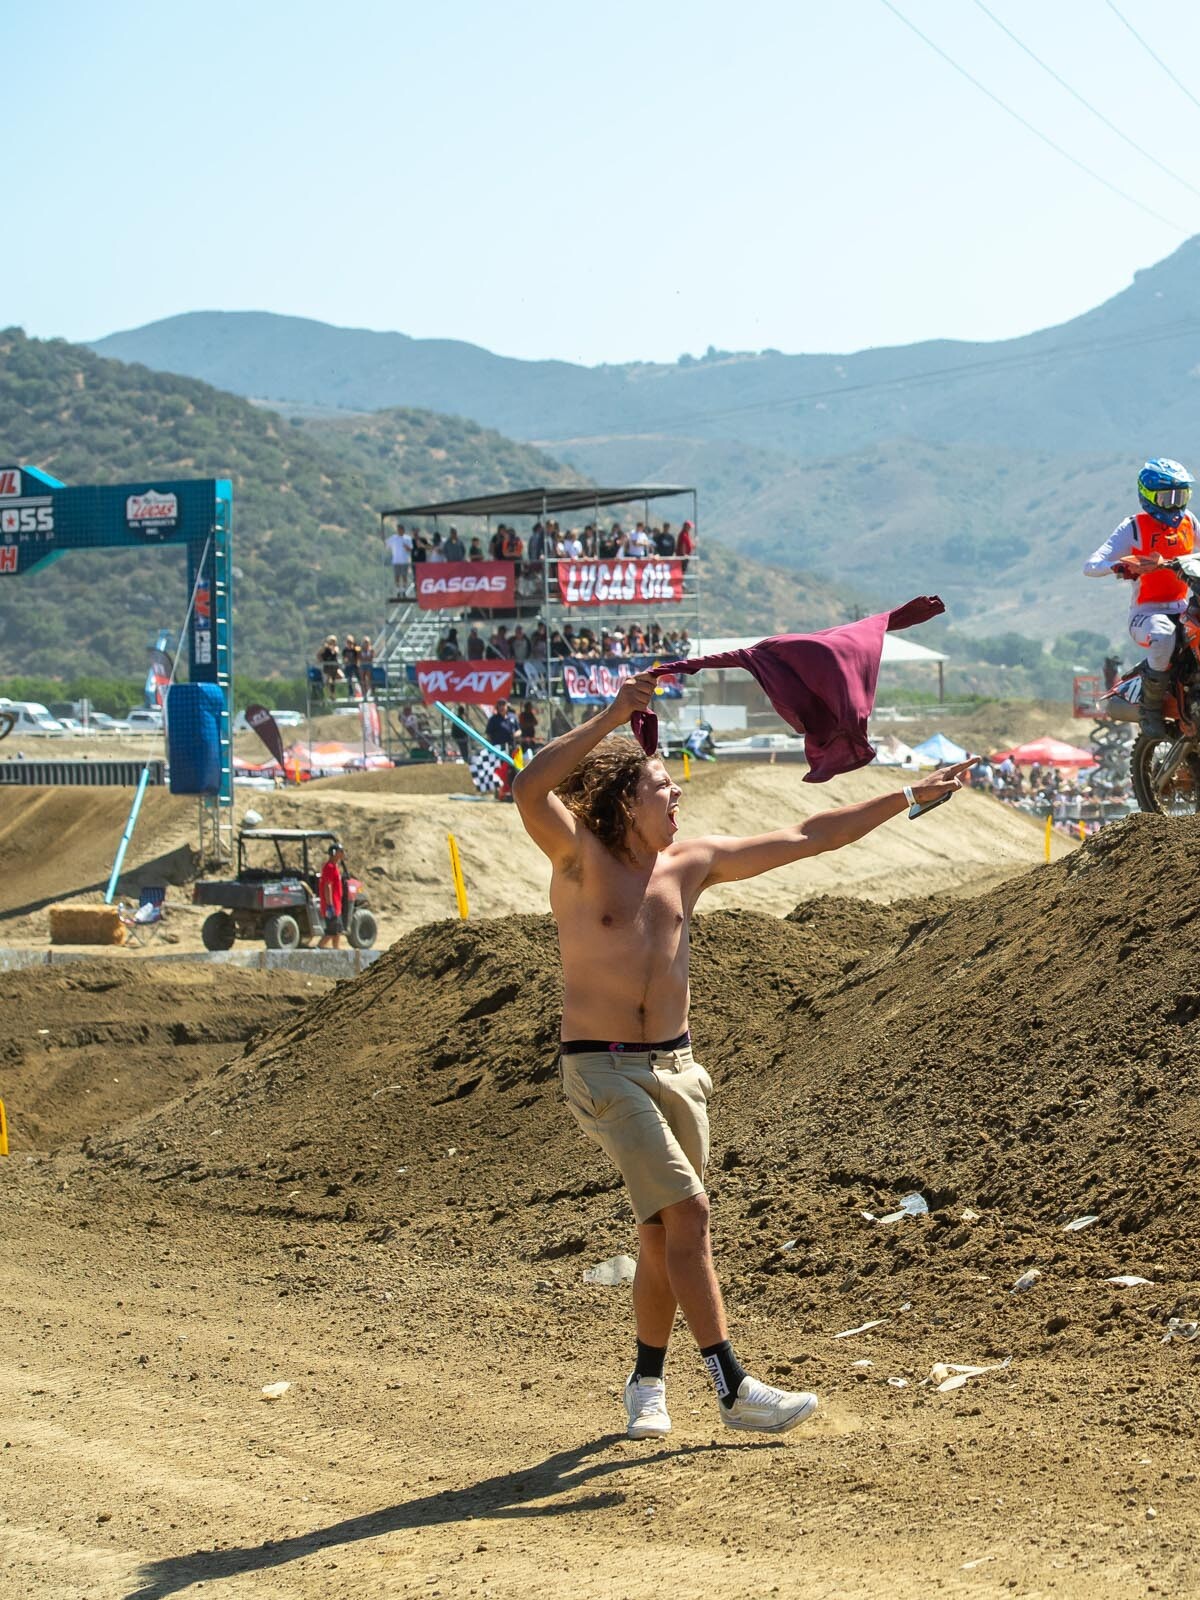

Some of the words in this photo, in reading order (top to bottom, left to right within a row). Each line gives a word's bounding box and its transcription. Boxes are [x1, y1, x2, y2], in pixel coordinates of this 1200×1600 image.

[0, 506, 54, 533] OSS
[420, 576, 506, 594] GASGAS
[566, 564, 638, 602] LUCAS
[641, 562, 675, 599] OIL
[418, 671, 511, 693] MX-ATV
[564, 666, 598, 698] Red
[704, 1356, 726, 1396] STANCE
